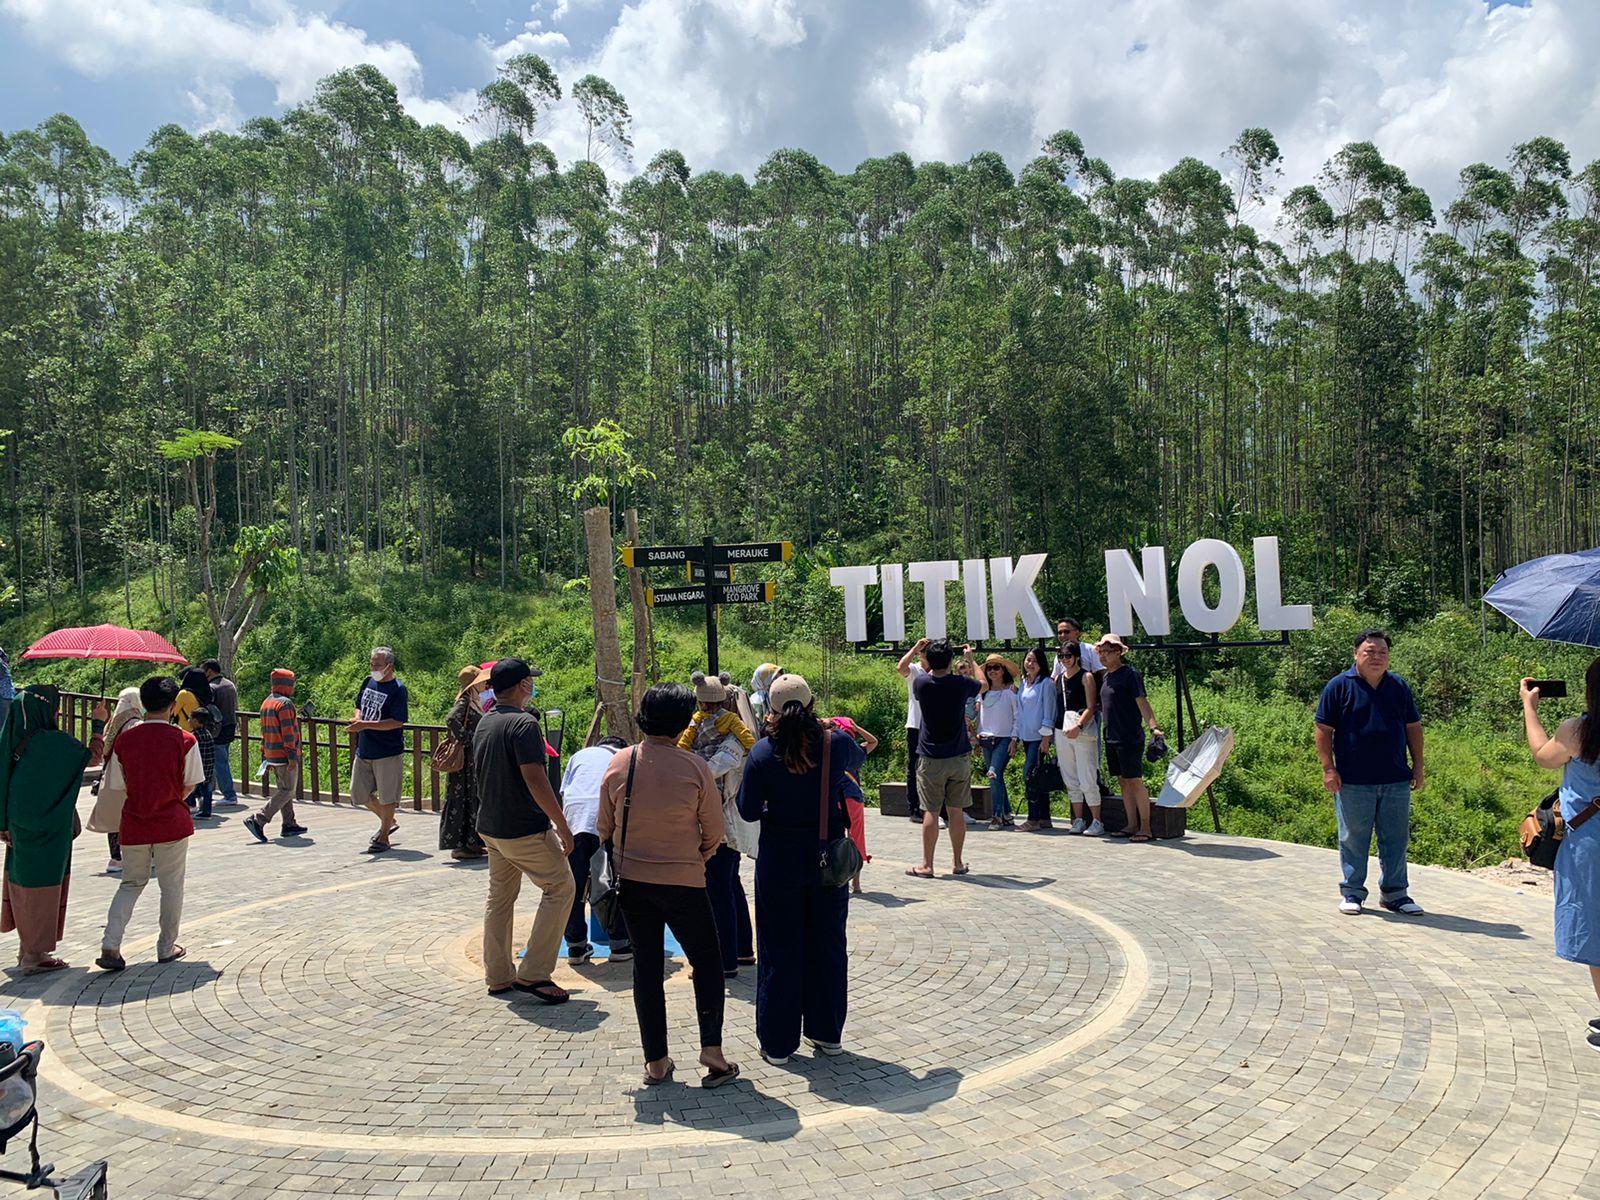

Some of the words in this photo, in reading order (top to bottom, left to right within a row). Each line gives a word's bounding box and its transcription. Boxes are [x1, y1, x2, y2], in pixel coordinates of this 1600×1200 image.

[648, 551, 685, 560] SABANG
[727, 549, 769, 558] MERAUKE
[723, 584, 760, 594] MANGROVE
[829, 553, 1055, 642] TITIK
[1104, 536, 1313, 637] NOL
[654, 593, 678, 602] ISTANA
[678, 591, 705, 601] NEGARA
[727, 594, 739, 602] ECO
[740, 592, 758, 601] PARK
